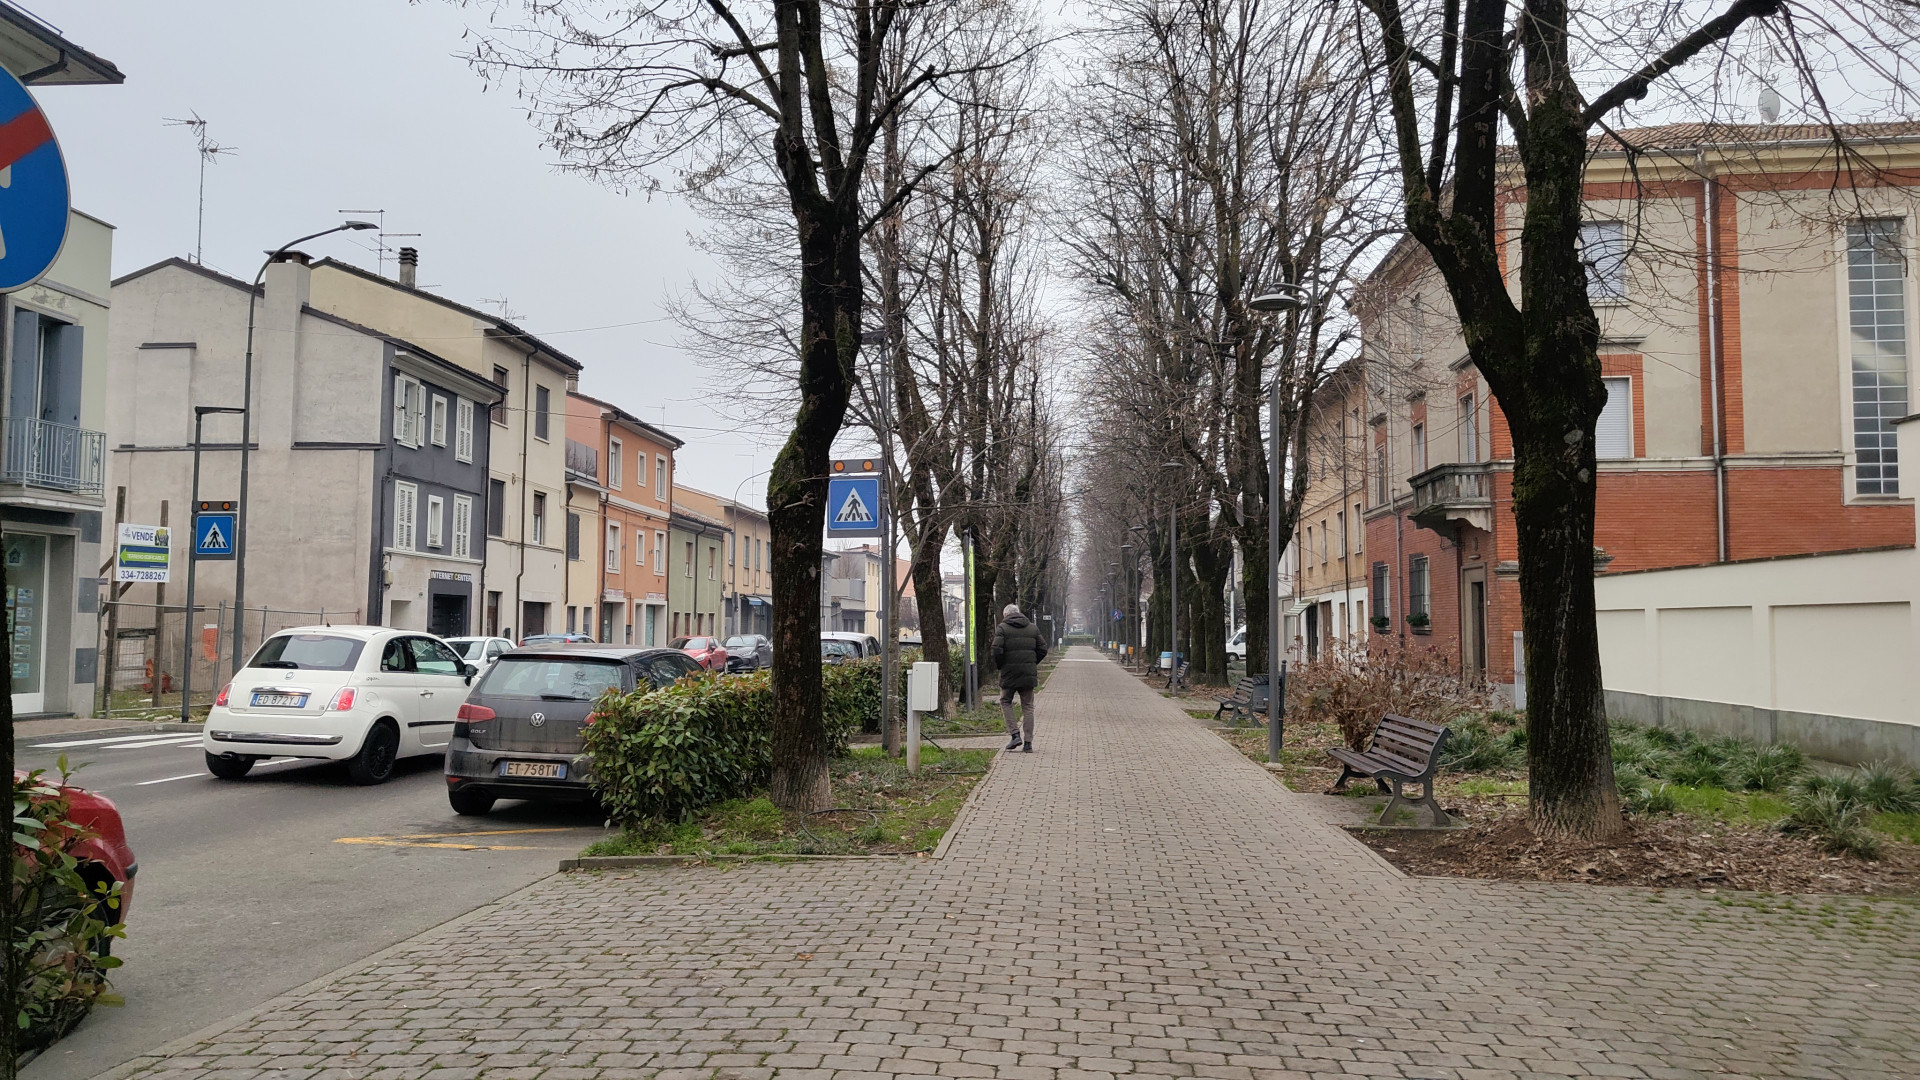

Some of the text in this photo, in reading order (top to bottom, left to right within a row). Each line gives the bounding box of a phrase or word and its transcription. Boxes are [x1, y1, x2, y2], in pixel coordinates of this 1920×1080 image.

[131, 531, 154, 541] VENDE
[120, 570, 166, 580] 334-7288267
[430, 571, 472, 582] INTERNET CENTER
[257, 695, 301, 705] ED 872YJ
[507, 763, 559, 776] ET 758TW
